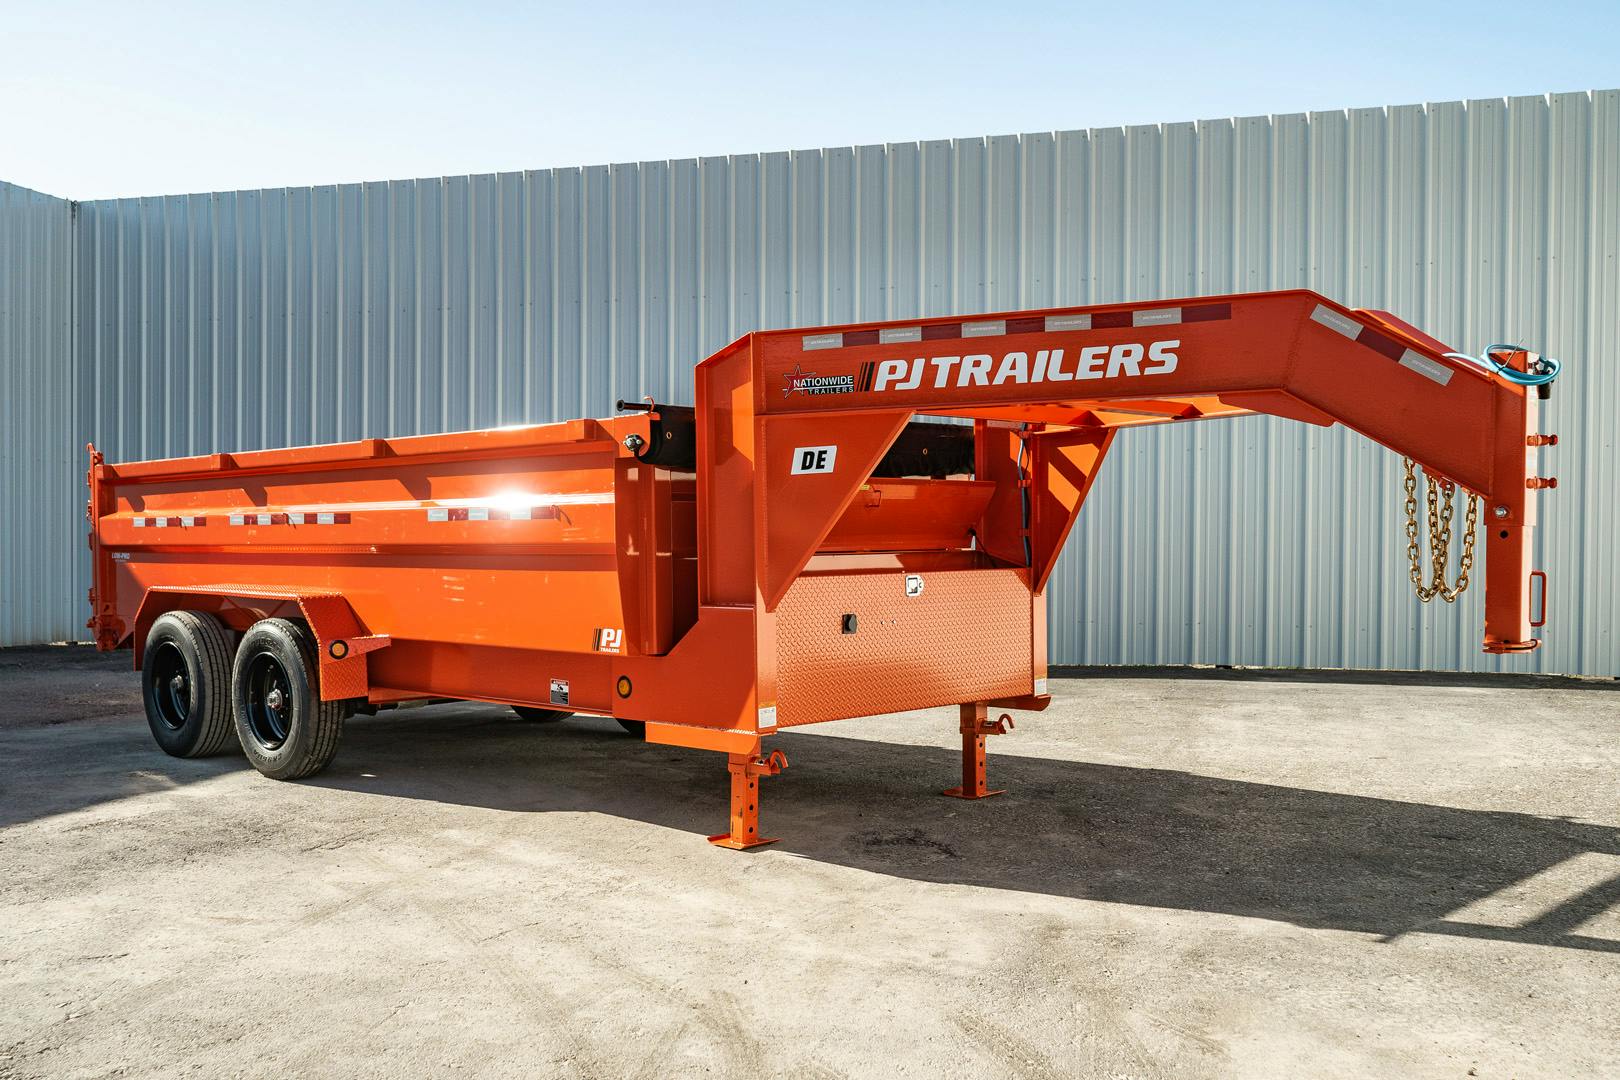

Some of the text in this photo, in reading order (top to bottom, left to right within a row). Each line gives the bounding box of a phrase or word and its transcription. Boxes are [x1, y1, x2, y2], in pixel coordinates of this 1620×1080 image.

[874, 338, 1181, 392] PJ TRAILERS
[793, 375, 854, 388] NATIONWIDE
[807, 386, 854, 395] TRAILERS
[800, 449, 828, 471] DE
[601, 628, 623, 648] PJ
